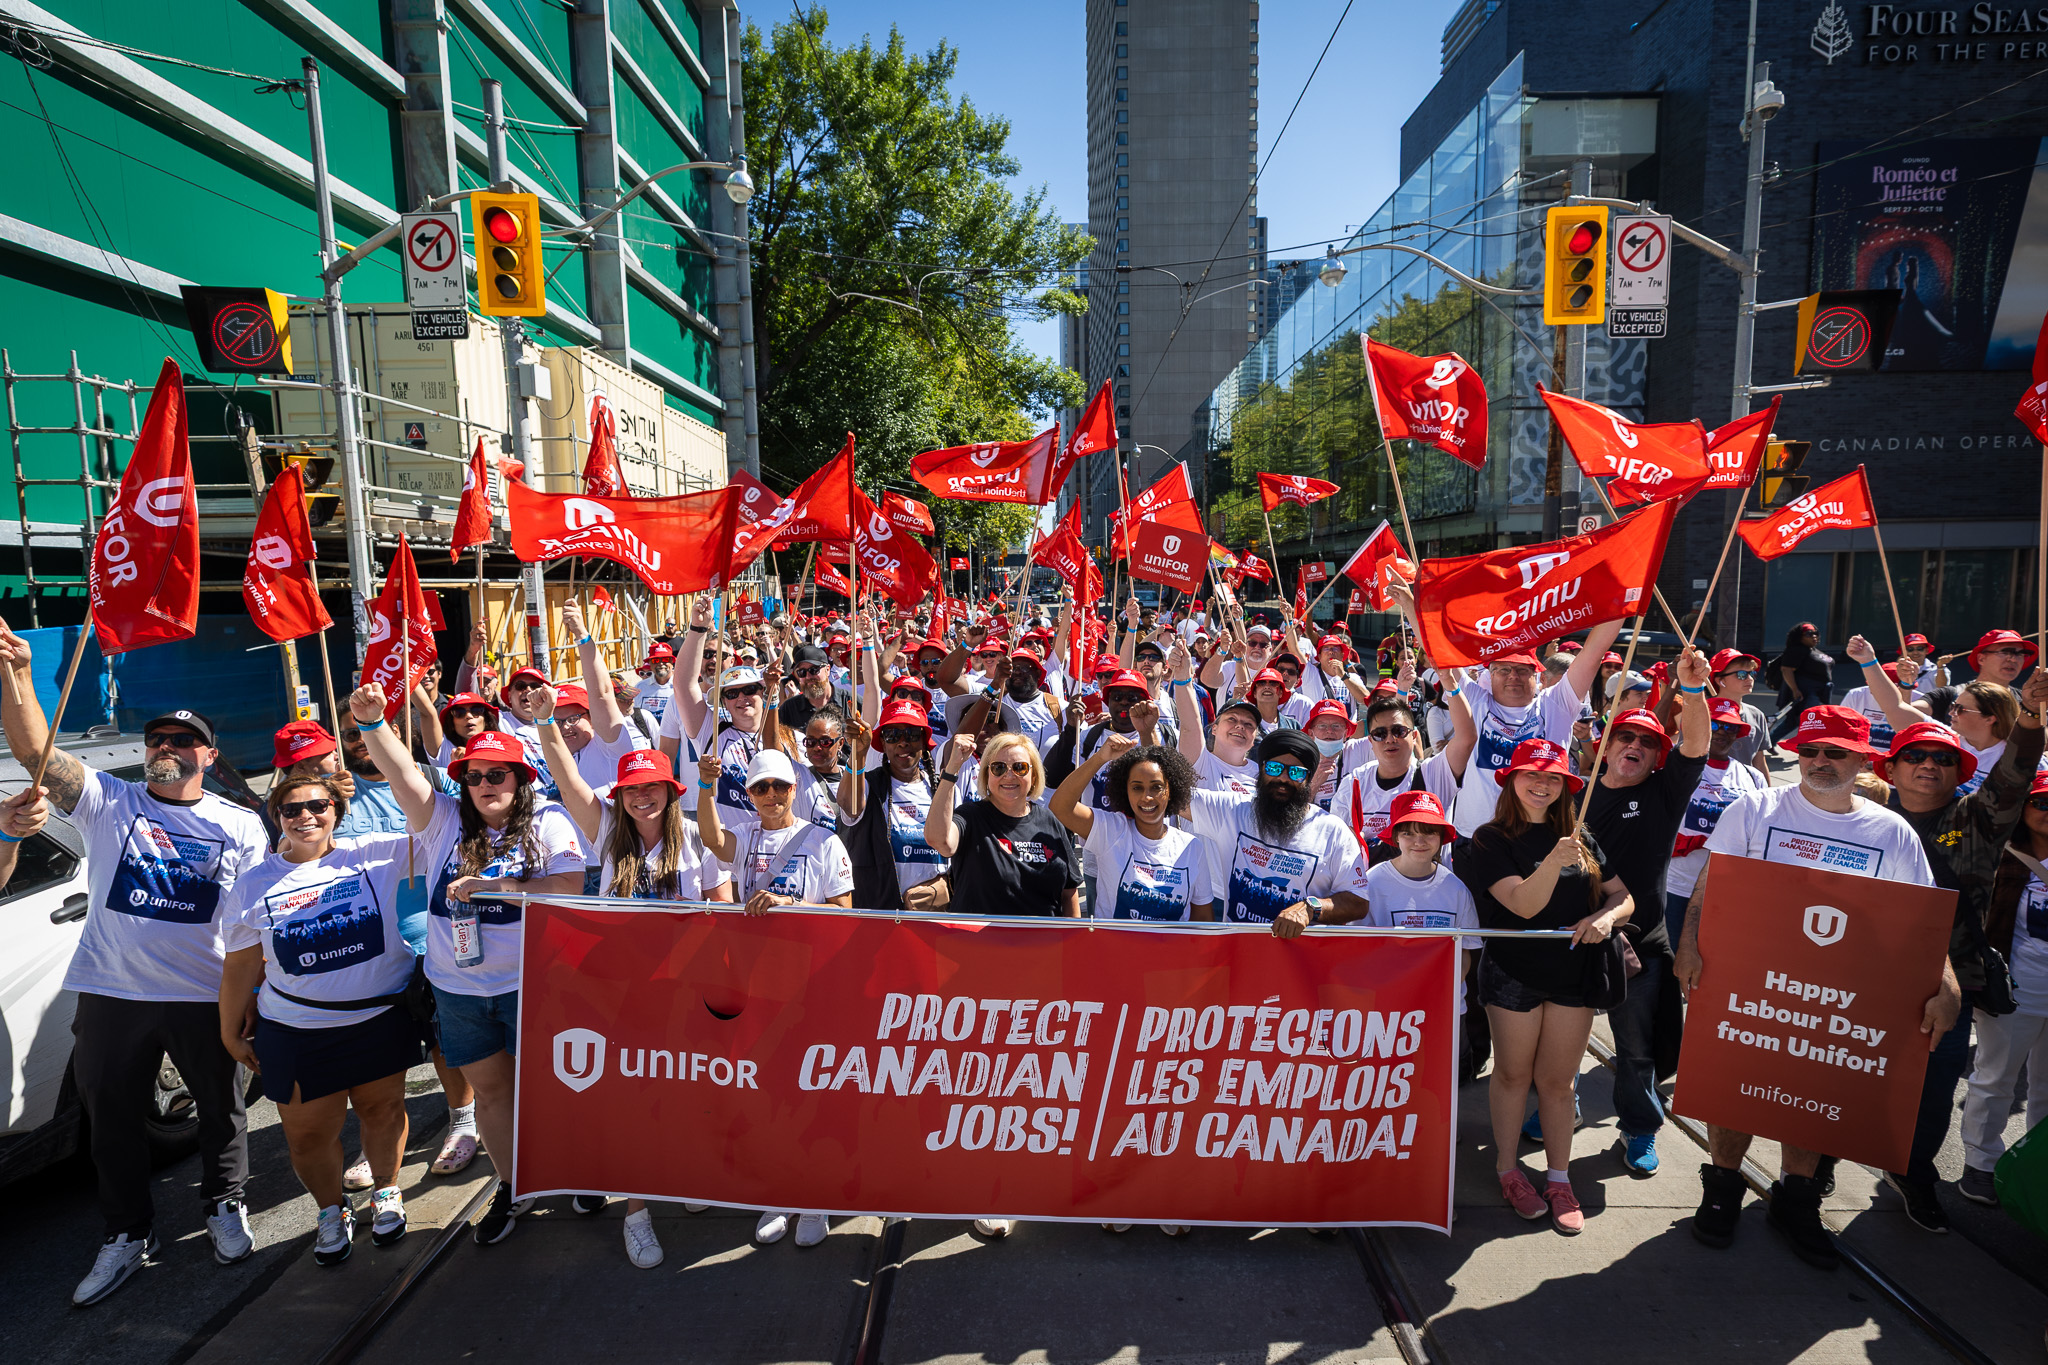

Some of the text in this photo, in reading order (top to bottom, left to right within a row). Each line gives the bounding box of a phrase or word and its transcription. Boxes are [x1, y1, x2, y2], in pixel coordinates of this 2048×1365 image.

[1867, 4, 1958, 37] FOUR
[1869, 45, 1918, 62] FOR
[1937, 43, 1987, 60] THE
[1872, 164, 1958, 184] Roméo et
[1878, 184, 1947, 202] Juliette
[413, 278, 428, 289] 7AM
[442, 276, 458, 288] 7PM
[1618, 278, 1633, 288] 7AM
[1648, 276, 1662, 288] 7PM
[412, 312, 467, 325] TTC VEHICLES
[1612, 312, 1665, 322] TTC VEHICLES
[416, 326, 465, 338] EXCEPTED
[1612, 324, 1662, 334] EXCEPTED
[392, 390, 408, 400] TARE
[1818, 434, 2034, 452] CANADIAN OPERA
[398, 473, 410, 482] NET
[1014, 841, 1042, 849] PROTECT
[1779, 842, 1820, 855] CANADIAN
[1790, 838, 1824, 849] PROTECT
[1017, 852, 1048, 863] JOBS
[1796, 852, 1818, 861] JOBS!
[1837, 854, 1868, 865] EMPLOIS
[1833, 860, 1868, 872] CANADA!
[1764, 970, 1857, 1010] Happy
[876, 992, 1104, 1047] PROTECT
[1136, 993, 1426, 1058] PROTÉGEONS
[1727, 992, 1887, 1048] Labour Day
[1716, 1020, 1888, 1076] from Unifor!
[798, 1044, 1090, 1102] CANADIAN
[1125, 1058, 1416, 1112] LES EMPLOIS
[1740, 1082, 1842, 1122] unifor.org
[925, 1104, 1080, 1156] JOBS!
[1110, 1111, 1418, 1164] AU CANADA!
